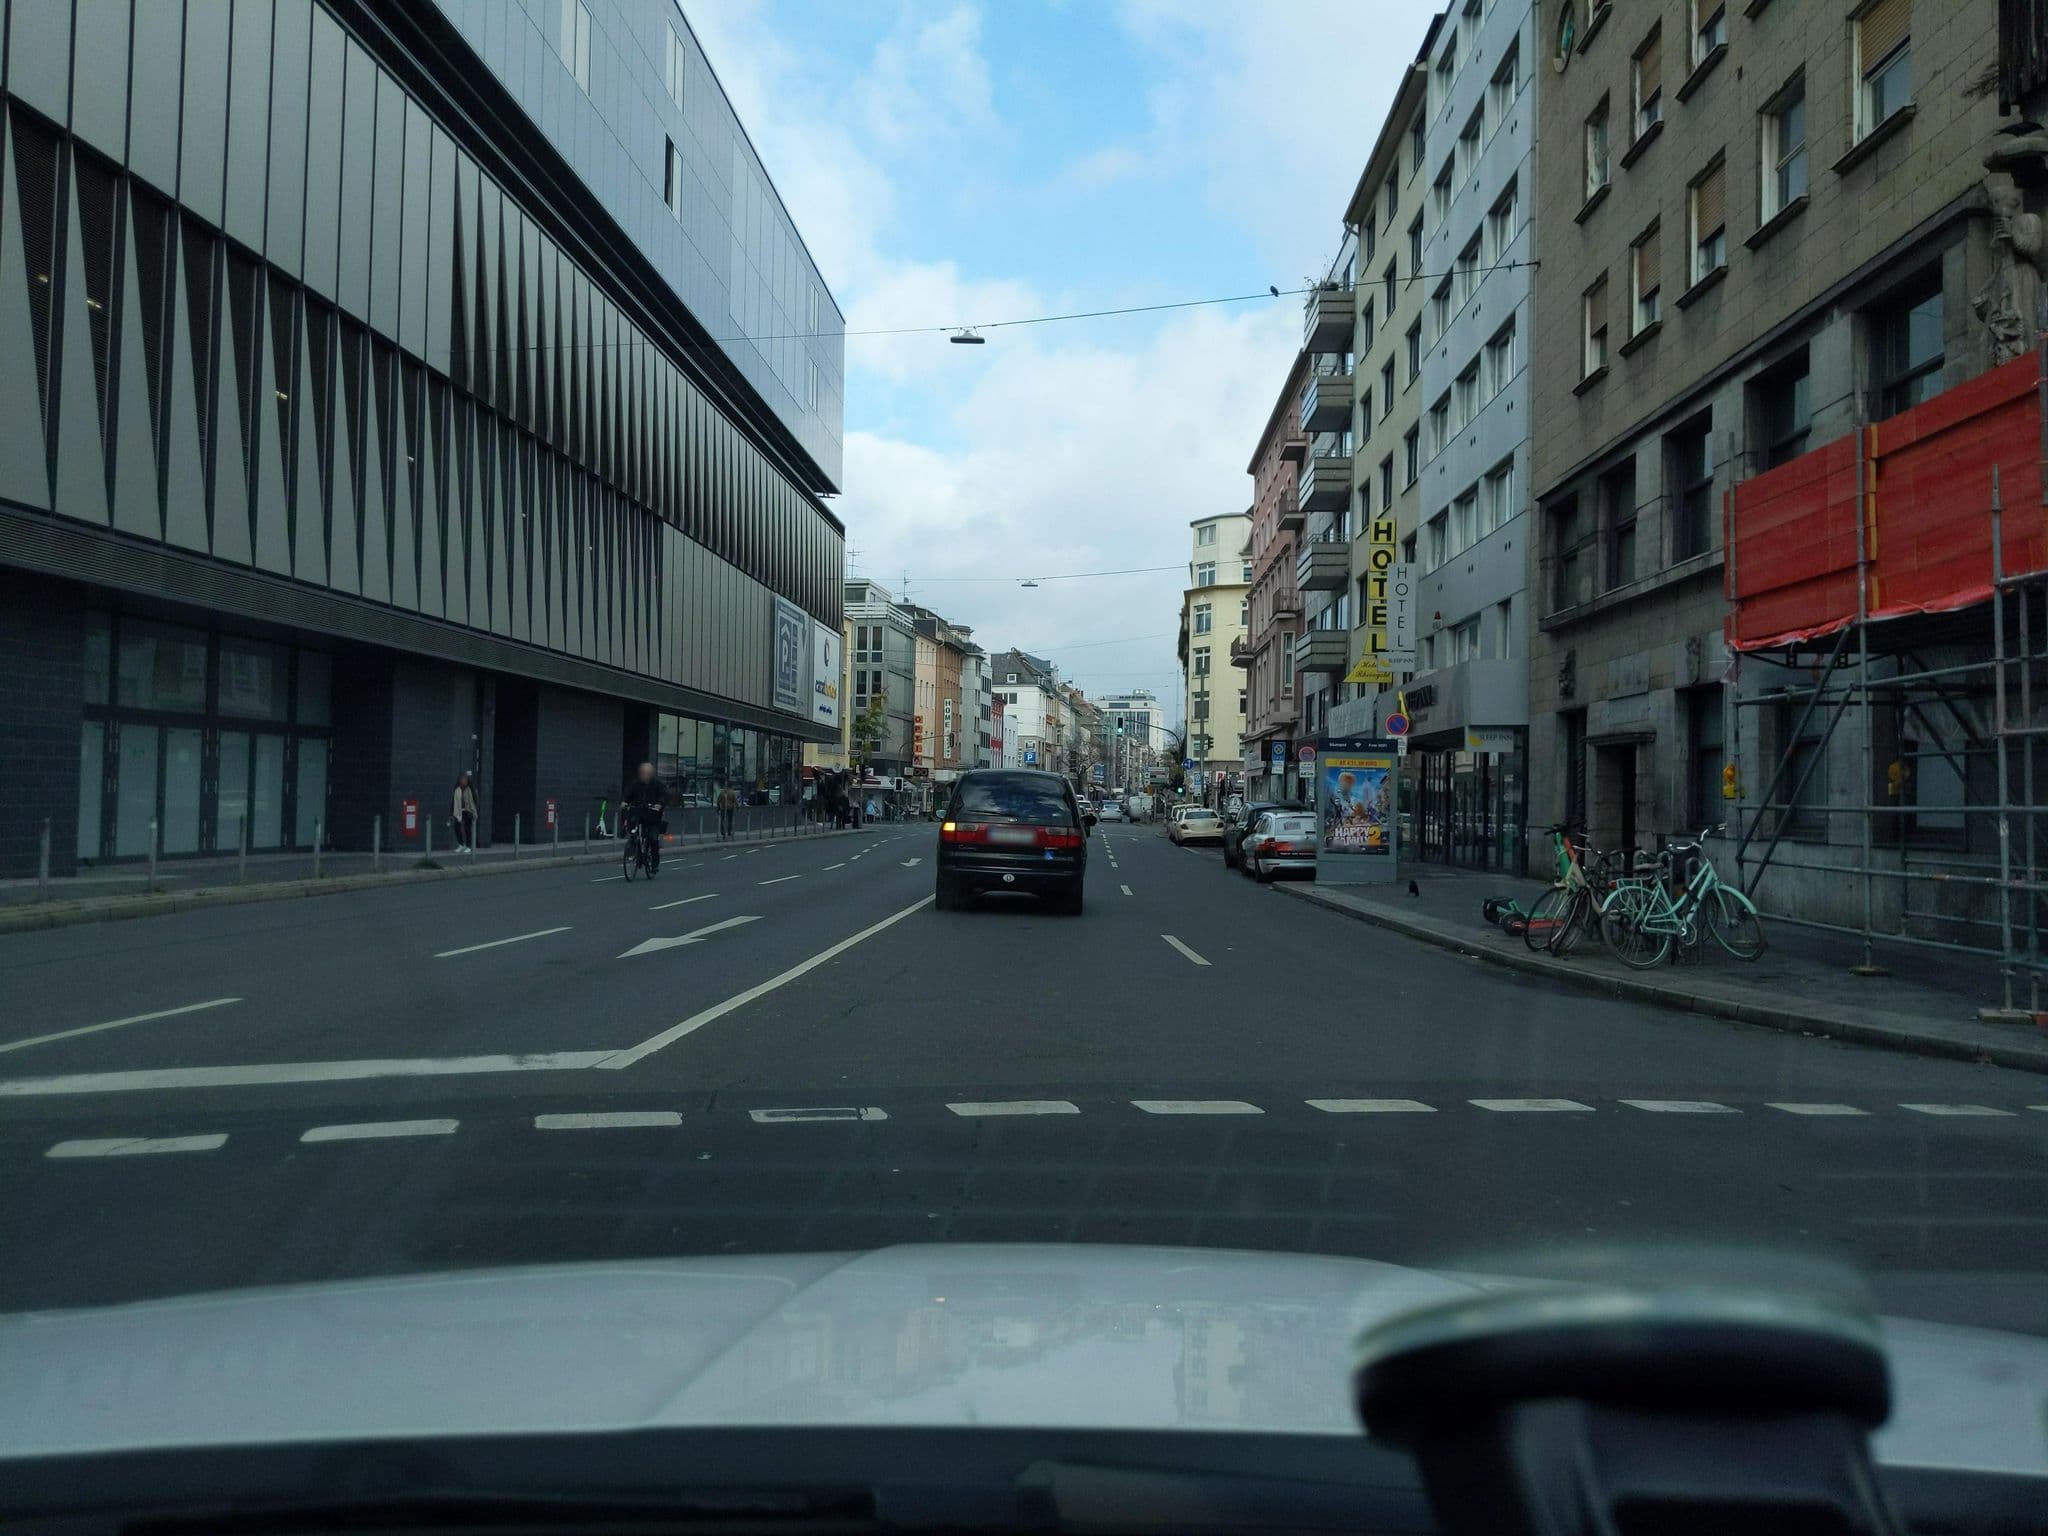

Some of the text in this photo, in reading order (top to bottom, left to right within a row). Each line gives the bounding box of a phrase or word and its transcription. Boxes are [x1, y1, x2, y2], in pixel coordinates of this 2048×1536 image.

[1371, 521, 1392, 653] HOTEL
[1394, 567, 1409, 648] HOTEL
[914, 716, 922, 761] OPTIK
[1335, 826, 1381, 845] HAPPY 2
